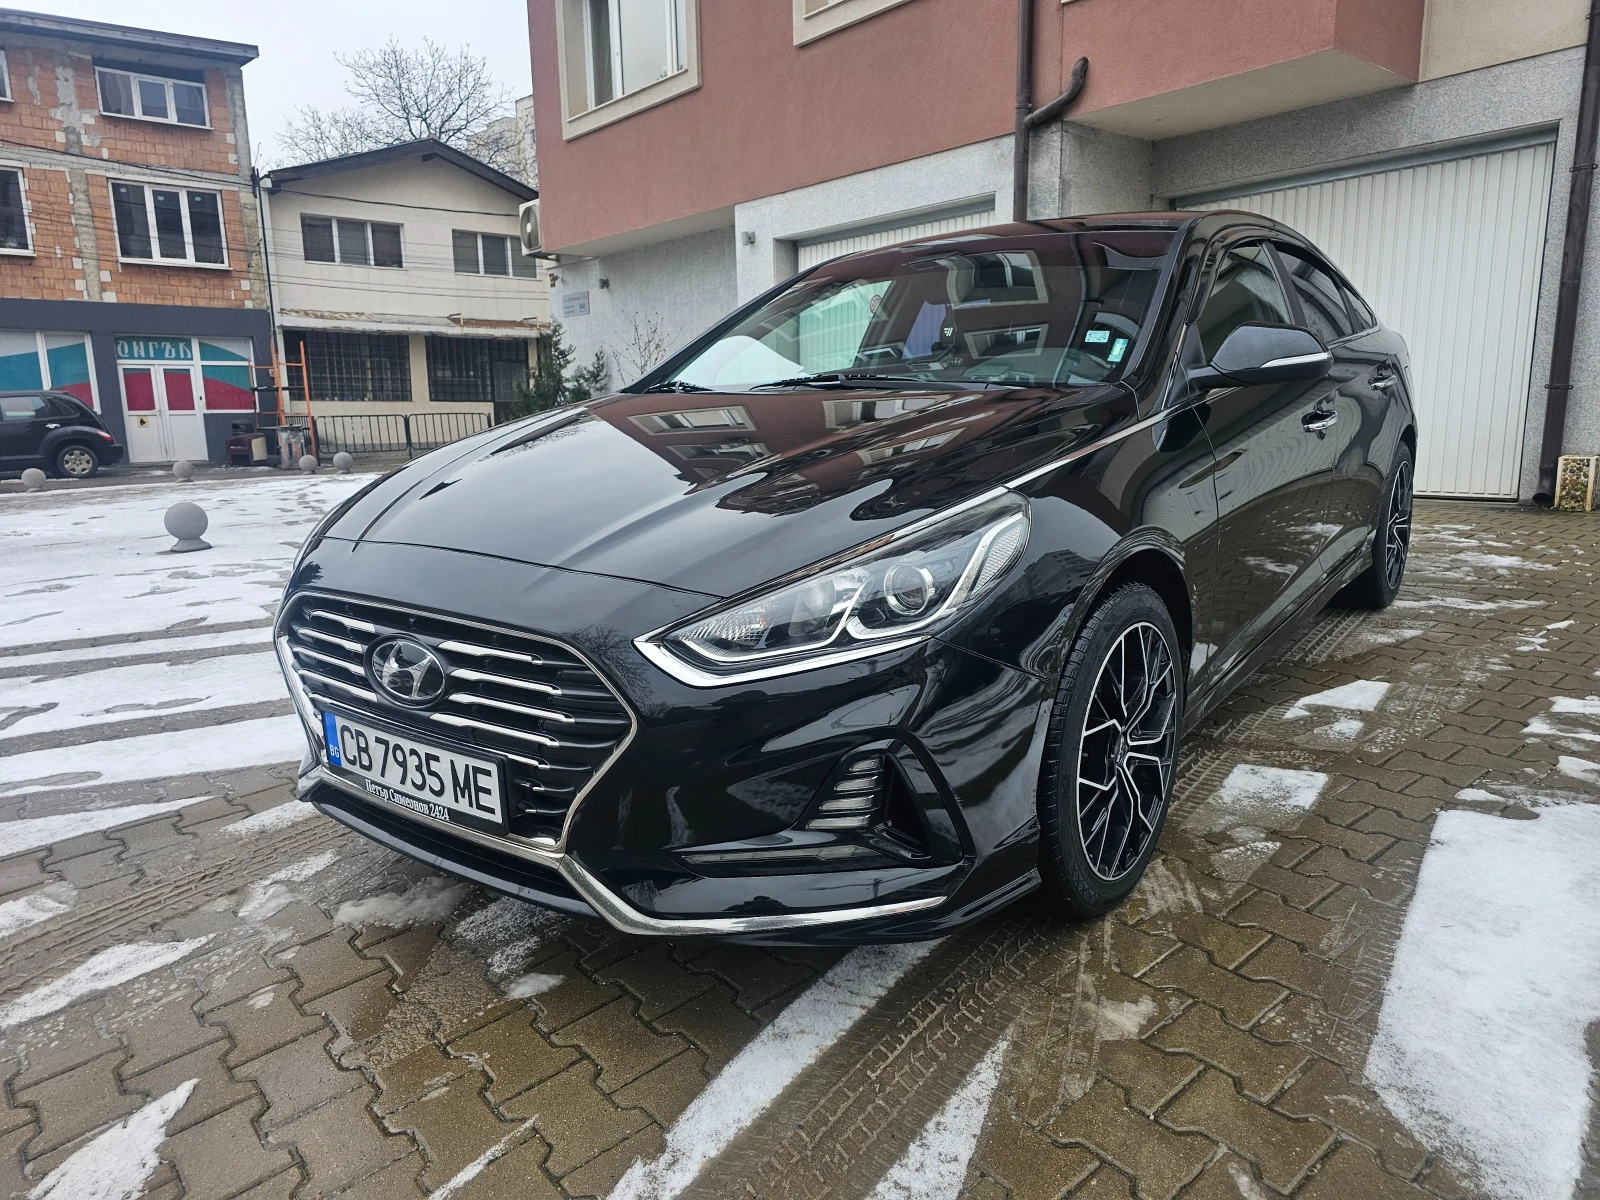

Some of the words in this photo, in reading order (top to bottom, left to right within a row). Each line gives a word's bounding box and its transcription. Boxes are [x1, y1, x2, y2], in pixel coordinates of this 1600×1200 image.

[329, 744, 340, 759] BG
[374, 735, 445, 797] 7935
[450, 758, 496, 815] ME
[365, 778, 389, 802] Петър
[389, 788, 430, 815] Симеонов
[430, 804, 450, 821] 2424
